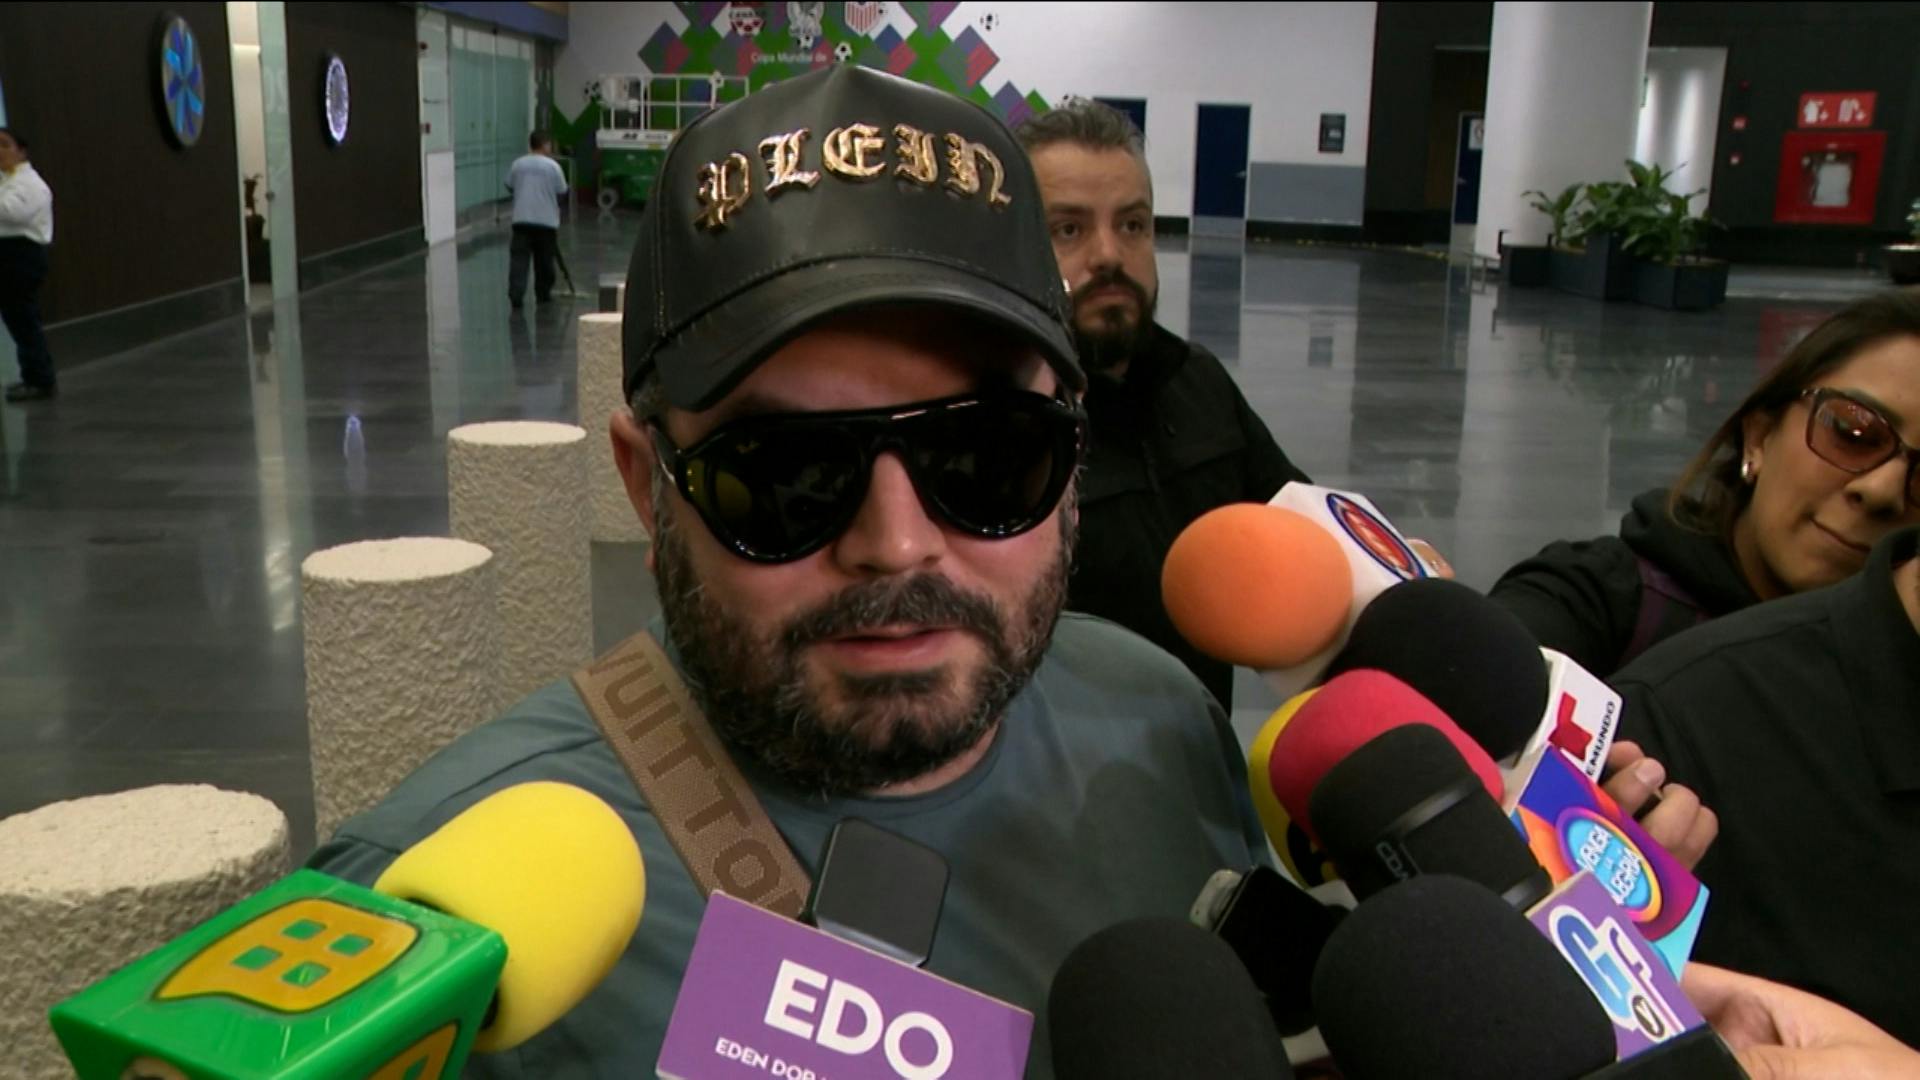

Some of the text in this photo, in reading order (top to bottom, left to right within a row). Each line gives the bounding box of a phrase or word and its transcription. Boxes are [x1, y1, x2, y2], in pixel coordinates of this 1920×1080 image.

[1585, 701, 1616, 777] EMUNDO
[763, 959, 954, 1080] EDO
[714, 1036, 829, 1080] EDEN DOR
